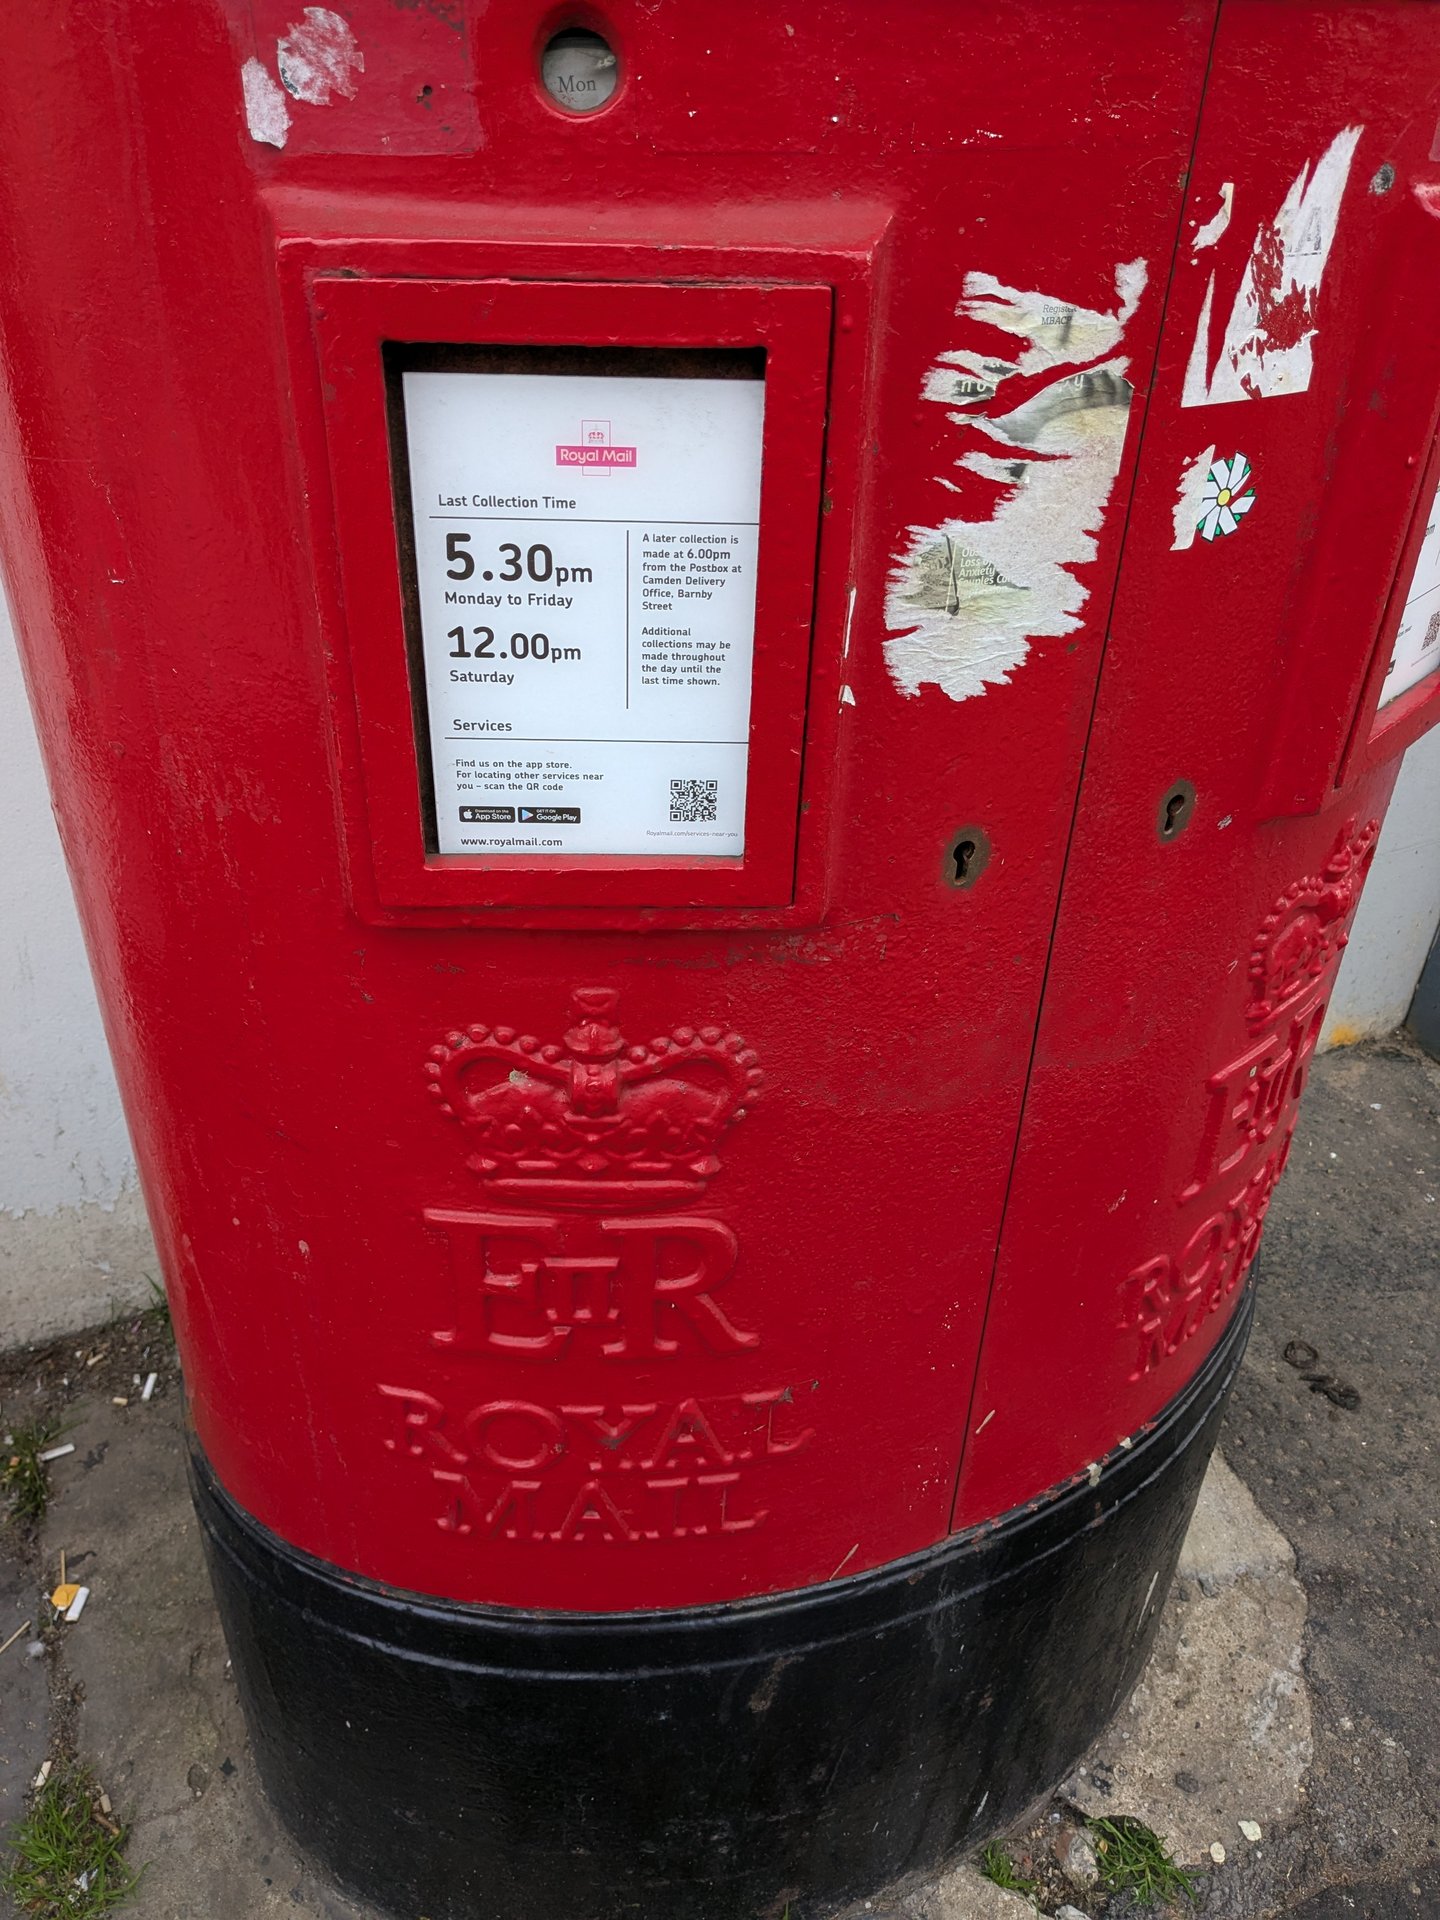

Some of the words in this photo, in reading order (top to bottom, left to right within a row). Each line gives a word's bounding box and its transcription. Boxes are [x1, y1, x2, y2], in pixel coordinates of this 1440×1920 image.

[557, 74, 597, 94] Mon
[1041, 315, 1073, 326] MBACP
[560, 448, 599, 464] Royal
[602, 449, 633, 463] Mail
[438, 493, 468, 507] Last
[472, 494, 539, 509] Collection
[541, 496, 577, 510] Time
[642, 533, 650, 543] A
[652, 533, 677, 543] later
[679, 534, 727, 545] collection
[730, 534, 739, 545] is
[445, 532, 593, 588] 5.30pm
[642, 549, 671, 559] made
[673, 550, 685, 559] at
[686, 548, 731, 562] 6.00pm
[642, 561, 667, 572] from
[669, 562, 687, 572] the
[689, 562, 729, 573] Postbox
[731, 564, 743, 574] at
[960, 558, 981, 568] Loss
[958, 567, 996, 578] Anxiety
[642, 574, 682, 585] Camden
[685, 575, 726, 588] Delivery
[642, 587, 674, 599] Office,
[677, 588, 713, 601] Barnby
[444, 591, 503, 608] Monday
[506, 593, 522, 606] to
[527, 592, 574, 610] Friday
[641, 600, 673, 611] Street
[641, 626, 692, 637] Additional
[446, 625, 582, 664] 12.00pm
[641, 639, 693, 649] collections
[695, 641, 717, 651] may
[718, 640, 731, 650] be
[641, 651, 669, 661] made
[670, 652, 726, 663] throughout
[641, 663, 658, 673] the
[660, 664, 678, 675] day
[680, 664, 703, 674] until
[705, 664, 722, 674] the
[449, 669, 515, 686] Saturday
[641, 675, 660, 685] last
[661, 676, 684, 686] time
[686, 676, 721, 686] shown.
[452, 718, 513, 732] Services
[455, 758, 476, 768] Find
[506, 759, 523, 768] the
[525, 761, 543, 770] app
[545, 761, 573, 769] store.
[456, 769, 472, 779] For
[474, 770, 512, 781] locating
[514, 771, 540, 780] other
[542, 771, 580, 781] services
[582, 773, 605, 781] near
[456, 783, 474, 792] you
[483, 783, 505, 791] scan
[507, 782, 524, 791] the
[526, 782, 540, 791] QR
[542, 782, 564, 791] code
[474, 812, 491, 821] App
[491, 812, 512, 821] Store
[536, 813, 562, 823] Google
[562, 813, 578, 822] Play
[460, 837, 563, 848] www.royalmail.com
[377, 1383, 818, 1472] ROYAL
[432, 1468, 770, 1542] MAIL
